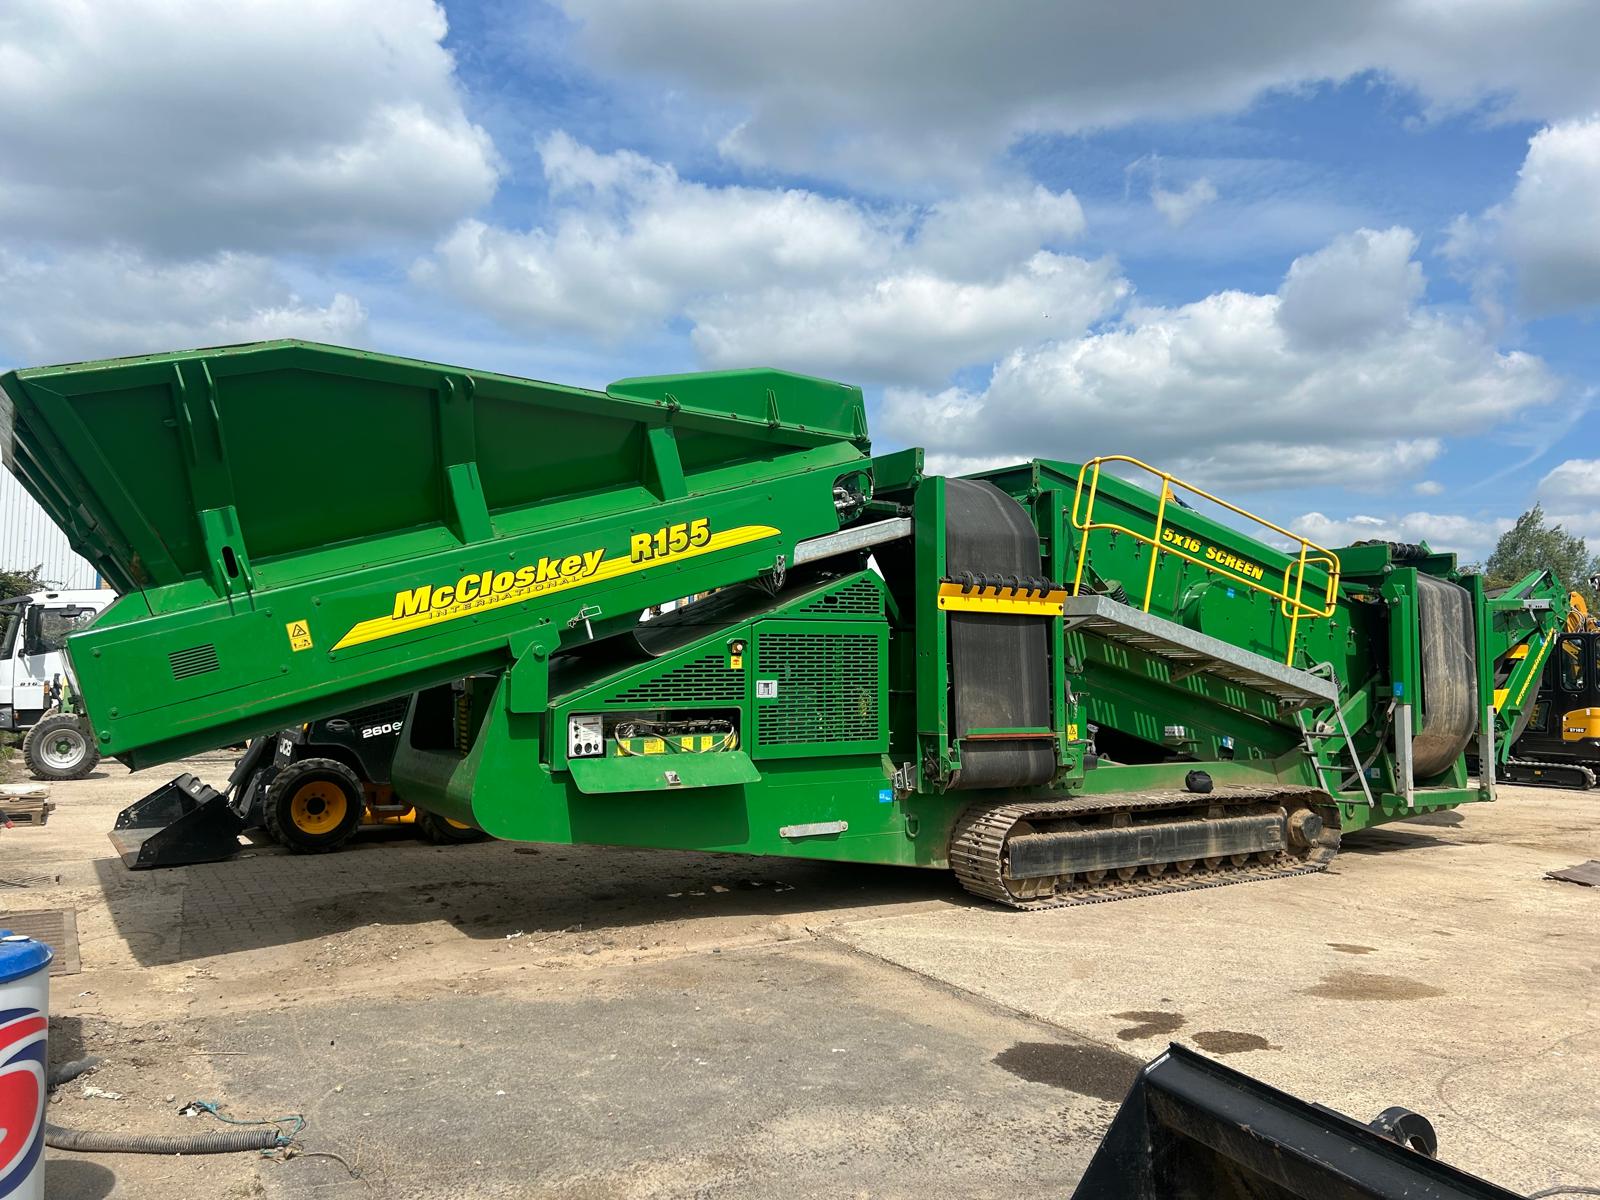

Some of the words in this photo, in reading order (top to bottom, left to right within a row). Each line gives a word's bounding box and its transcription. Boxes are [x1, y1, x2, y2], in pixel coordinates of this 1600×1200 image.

[631, 517, 712, 563] R155
[1162, 528, 1202, 553] 5x16
[1205, 546, 1265, 581] SCREEN
[392, 548, 605, 620] McCloskey
[428, 575, 581, 620] INTERNATIONAL
